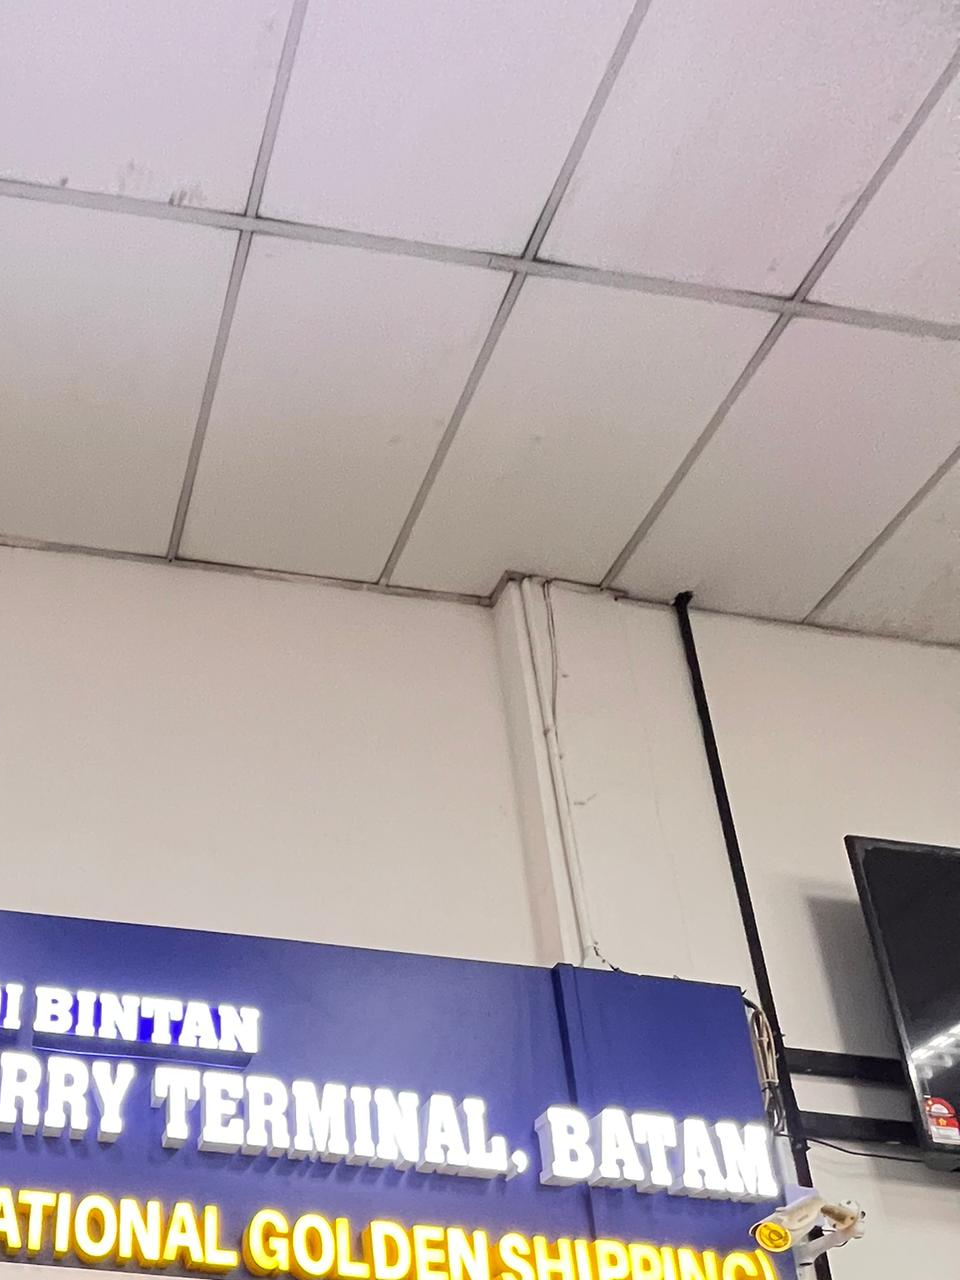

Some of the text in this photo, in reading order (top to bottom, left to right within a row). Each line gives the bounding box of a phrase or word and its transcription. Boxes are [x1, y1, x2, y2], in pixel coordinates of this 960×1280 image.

[32, 984, 260, 1053] BINTAN
[154, 1066, 528, 1176] TERMINAL,
[547, 1105, 777, 1197] BATAM
